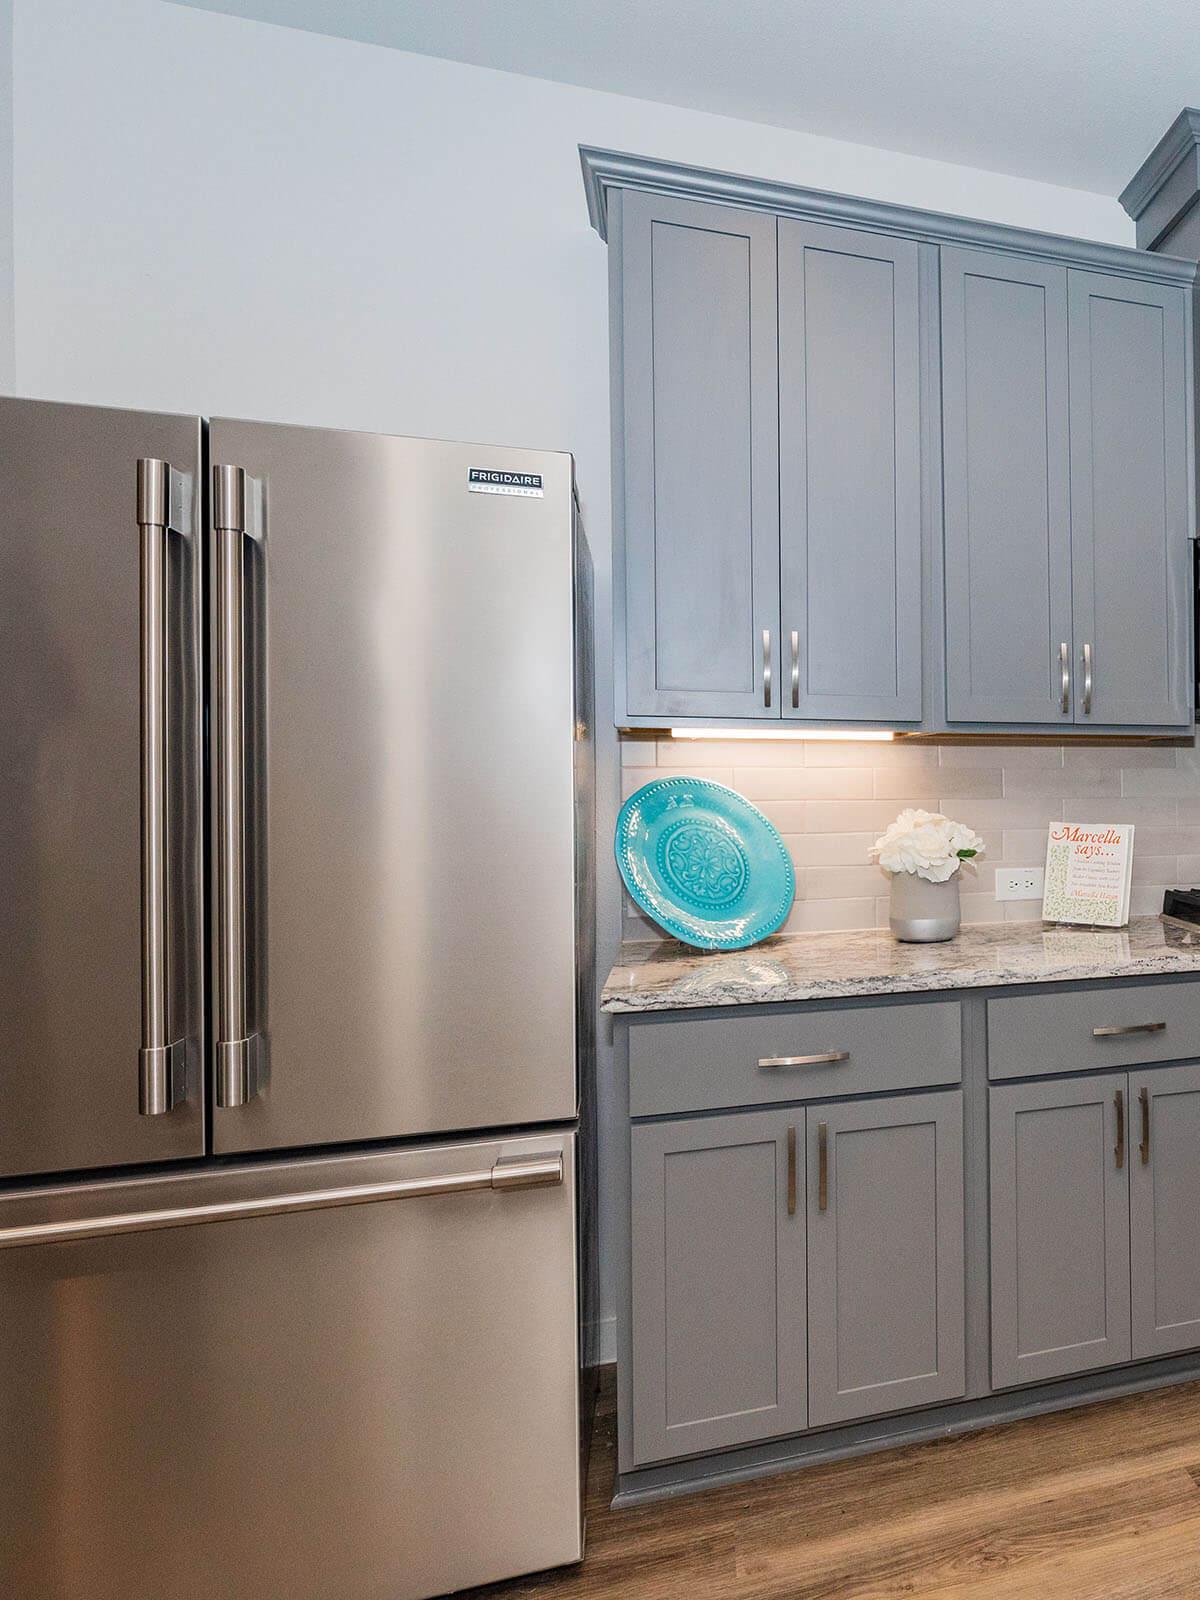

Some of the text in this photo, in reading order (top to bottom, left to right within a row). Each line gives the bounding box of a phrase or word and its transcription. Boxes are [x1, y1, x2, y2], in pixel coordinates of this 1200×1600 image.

[471, 471, 540, 486] FRIGIDAIRE
[1051, 826, 1121, 844] Marcella
[1074, 844, 1115, 859] says...
